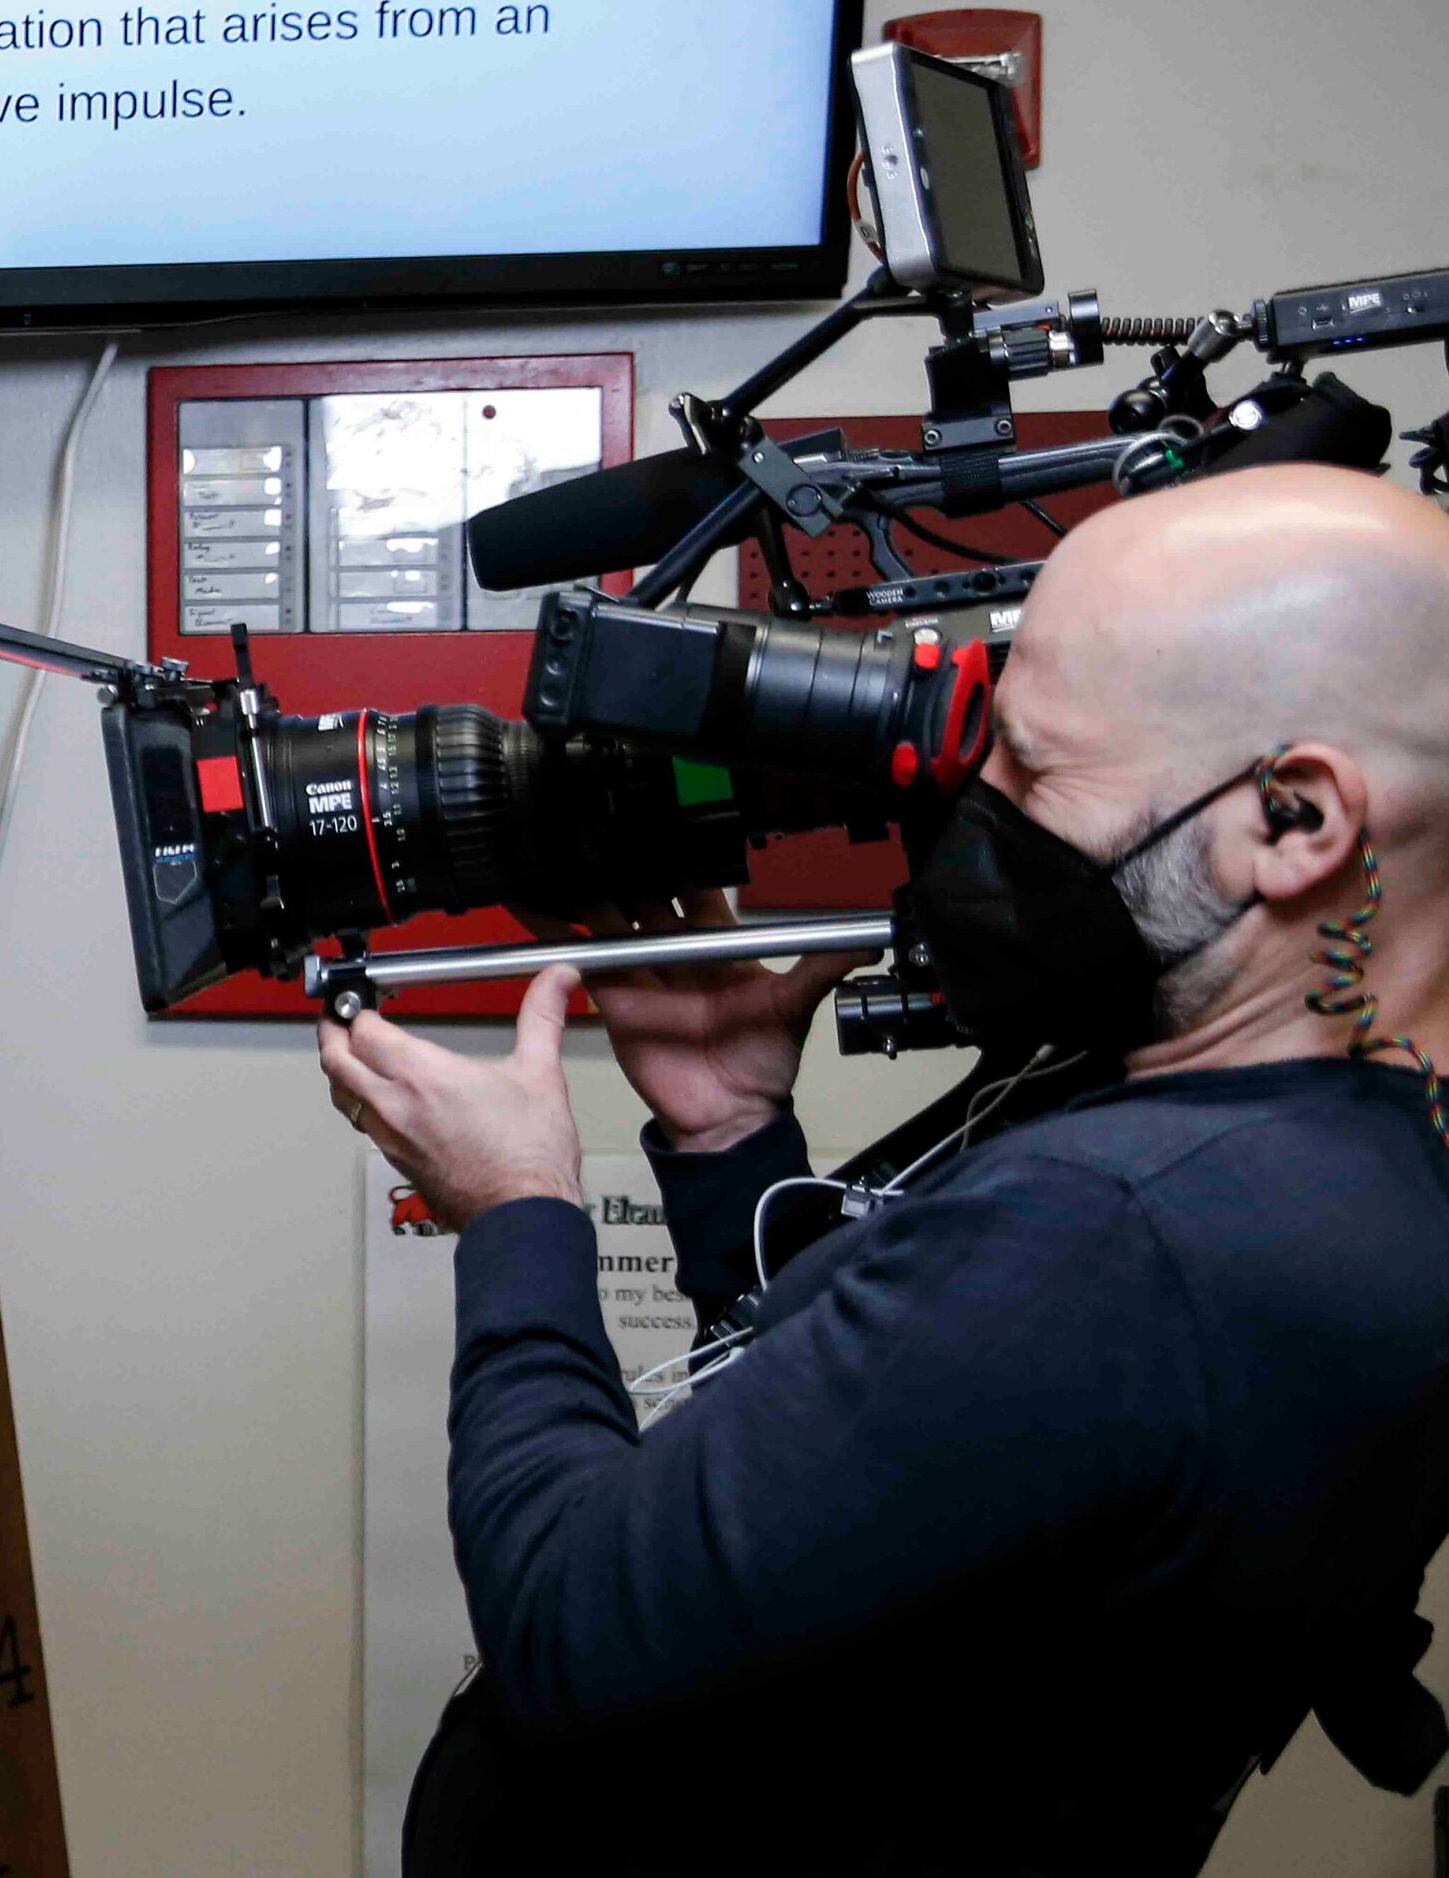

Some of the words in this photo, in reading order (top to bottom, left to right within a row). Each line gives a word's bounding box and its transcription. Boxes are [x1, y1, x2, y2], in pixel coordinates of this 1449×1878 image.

[122, 7, 204, 45] that
[224, 3, 357, 42] arises
[377, 0, 475, 37] from
[497, 5, 548, 34] an
[60, 80, 244, 130] impulse.
[1349, 292, 1380, 308] MPE
[866, 588, 903, 600] WOODEN
[869, 596, 903, 606] CAMERA
[305, 780, 352, 796] Canon
[309, 792, 353, 814] MPE
[309, 815, 357, 836] 17-120
[615, 1287, 645, 1306] my
[653, 1284, 687, 1302] bes
